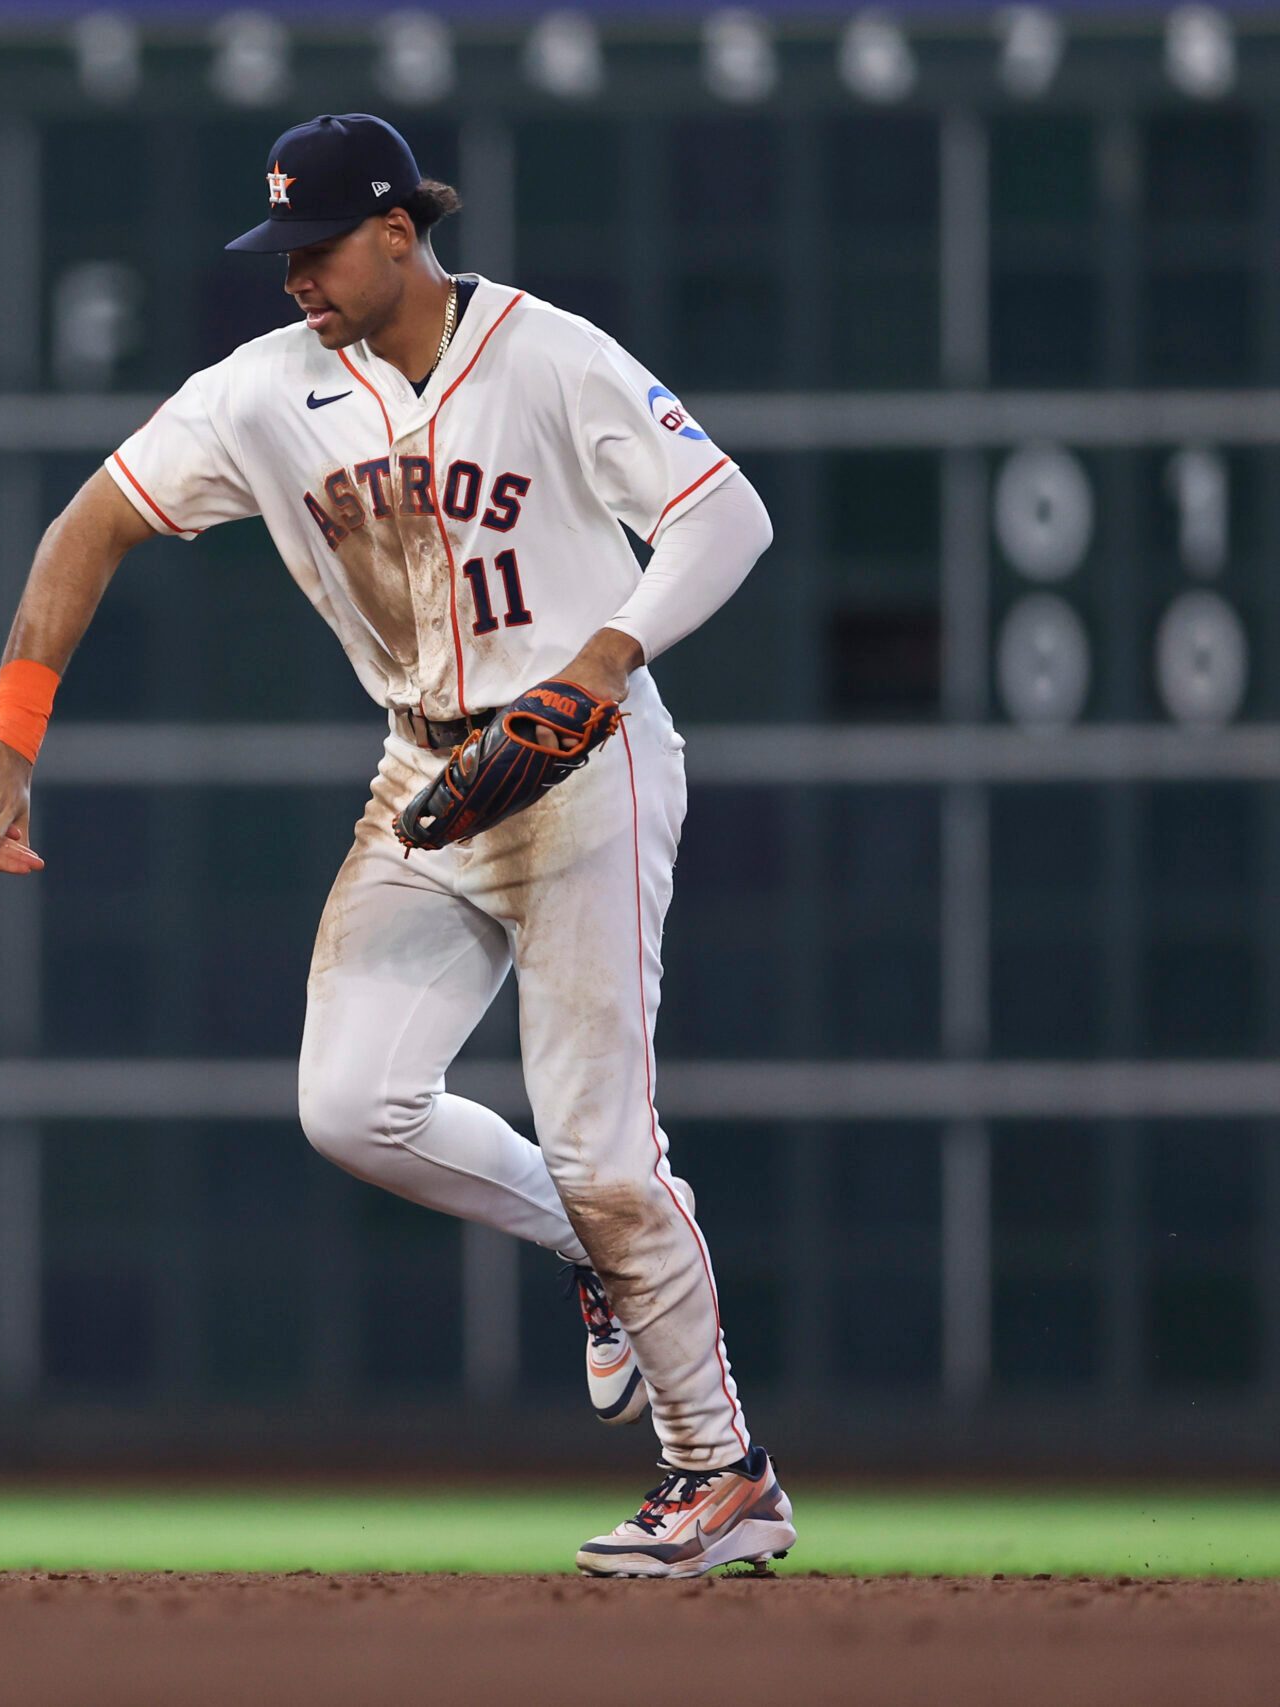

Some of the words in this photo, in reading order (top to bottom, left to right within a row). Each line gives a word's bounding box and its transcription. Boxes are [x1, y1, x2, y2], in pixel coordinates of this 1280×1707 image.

[267, 172, 290, 203] H
[303, 455, 532, 552] ASTROS
[463, 548, 533, 636] 11
